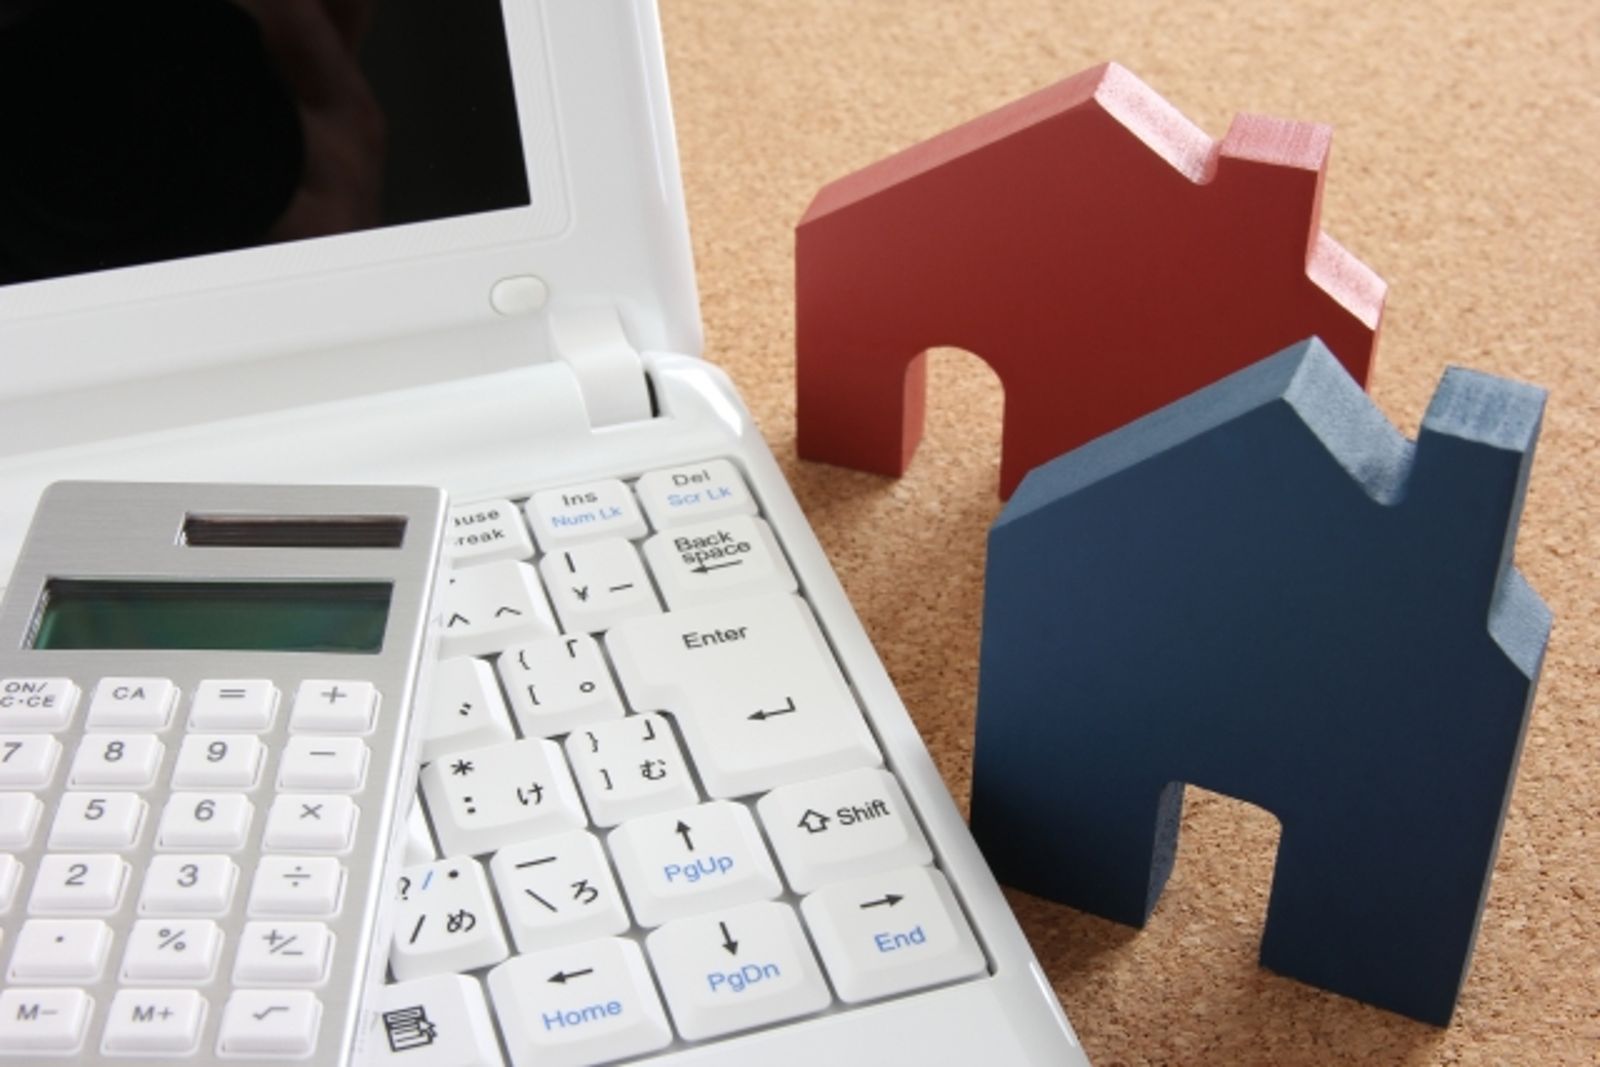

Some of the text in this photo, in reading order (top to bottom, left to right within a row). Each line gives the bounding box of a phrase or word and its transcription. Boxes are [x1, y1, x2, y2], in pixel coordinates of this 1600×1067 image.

[672, 470, 711, 487] Del
[562, 492, 598, 506] Ins
[667, 487, 732, 507] Scr Lk
[551, 507, 622, 528] Num Lk
[455, 529, 504, 545] reak
[674, 530, 733, 552] Back
[682, 541, 751, 565] space
[682, 627, 747, 649] Enter
[4, 682, 47, 693] ON/
[112, 687, 145, 700] CA
[2, 742, 23, 762] 7
[104, 741, 125, 762] 8
[207, 741, 228, 762] 9
[640, 760, 666, 780] む
[517, 783, 543, 805] け
[84, 799, 106, 820] 5
[194, 799, 216, 822] 6
[836, 799, 890, 825] Shift
[64, 864, 88, 886] 2
[177, 864, 199, 888] 3
[664, 856, 733, 883] PgUp
[571, 880, 598, 904] ろ
[447, 909, 476, 933] め
[158, 928, 186, 952] %
[874, 926, 926, 952] End
[707, 964, 780, 992] PgDn
[132, 1006, 173, 1022] M+
[542, 1001, 623, 1031] Home
